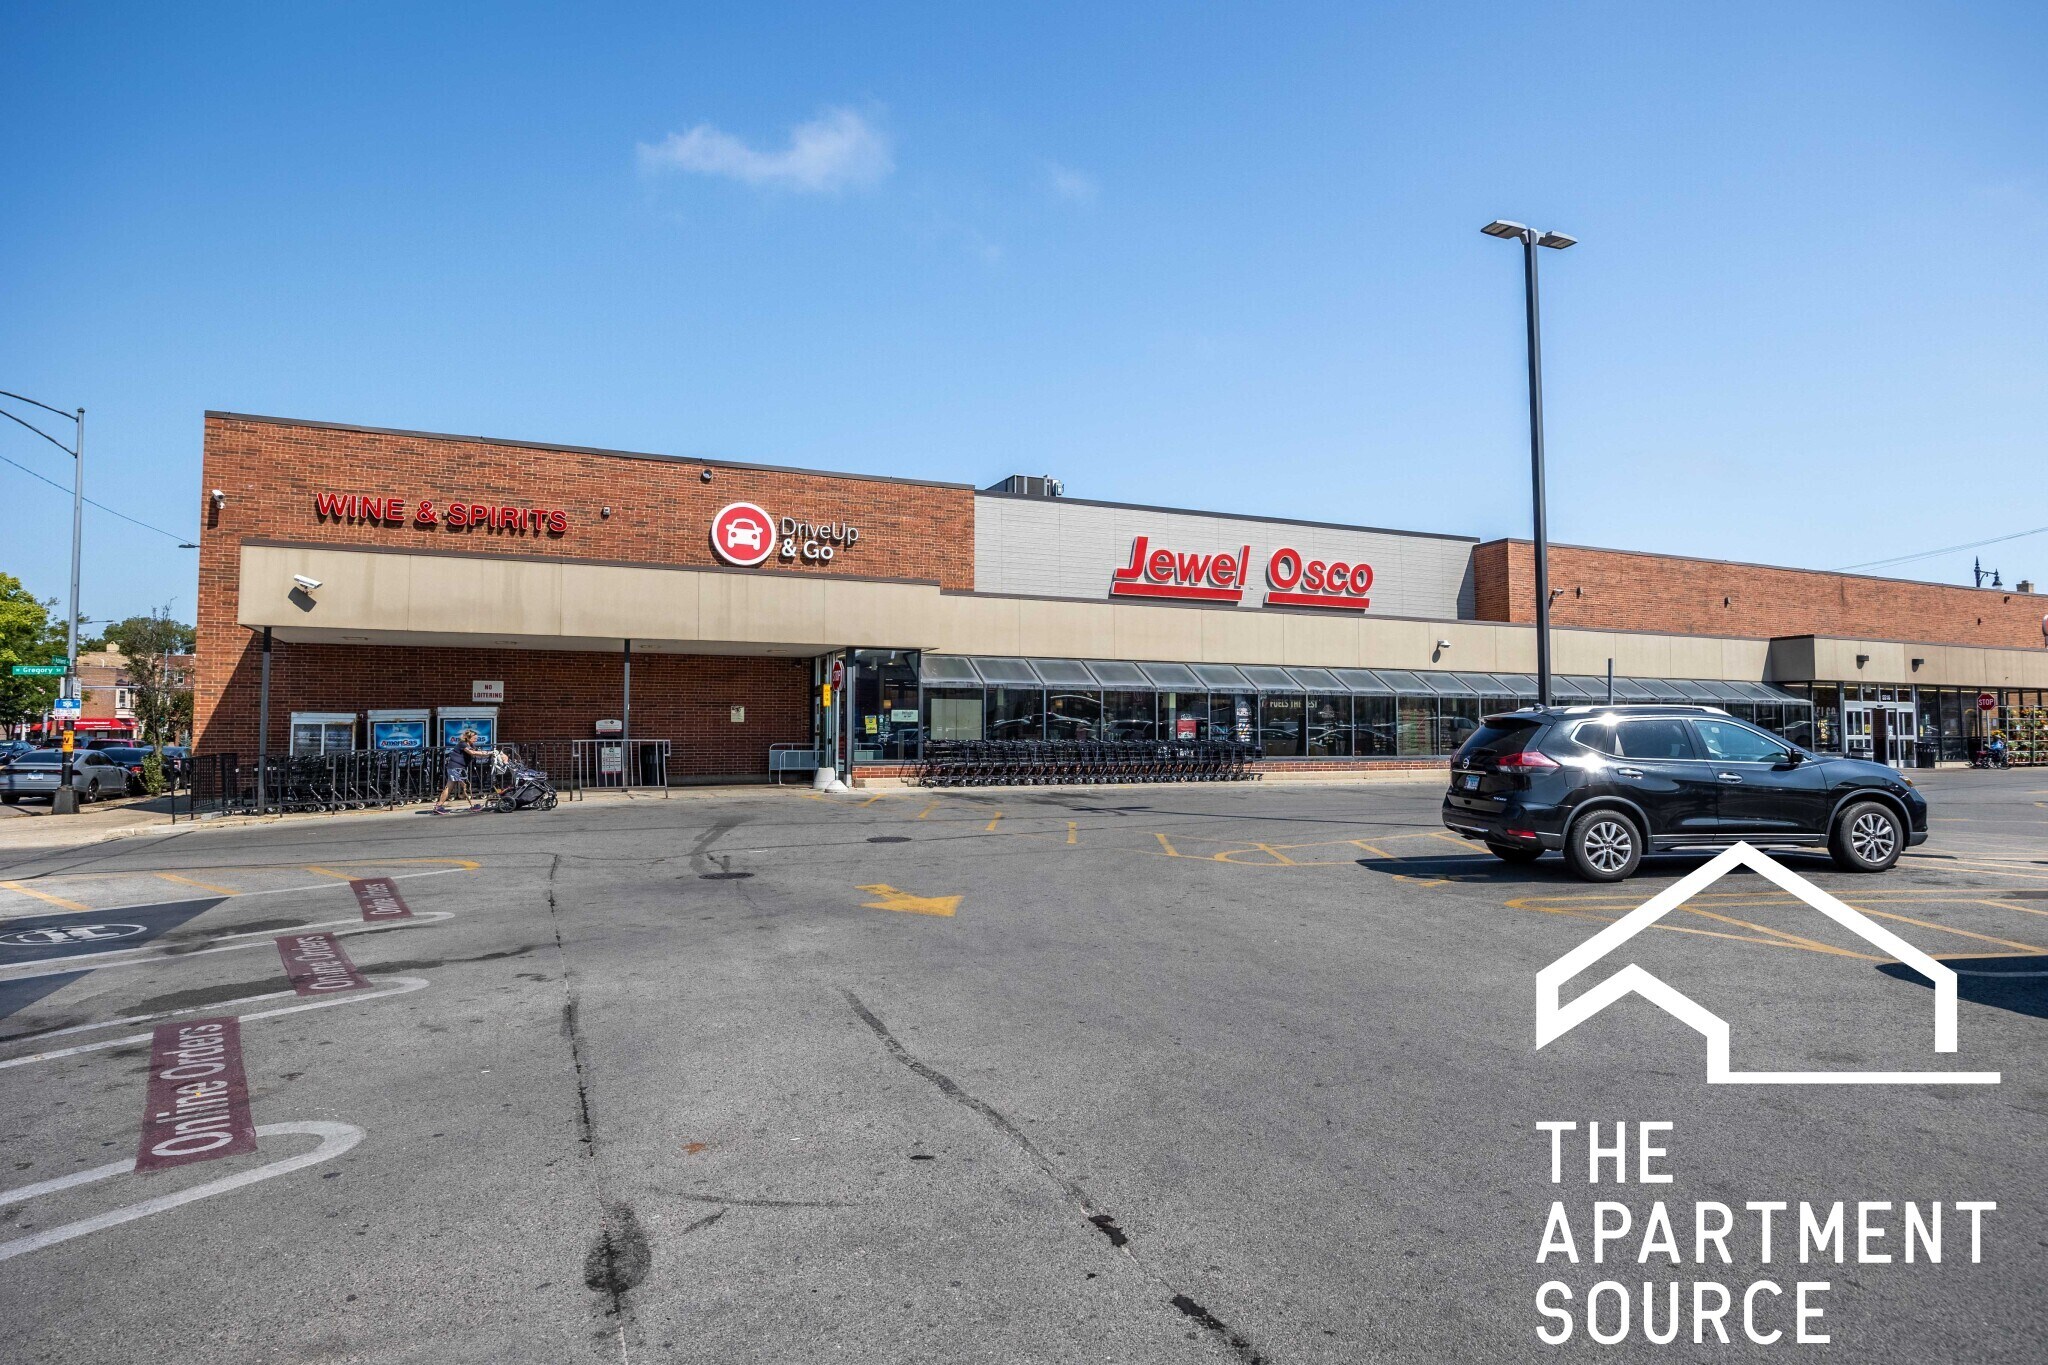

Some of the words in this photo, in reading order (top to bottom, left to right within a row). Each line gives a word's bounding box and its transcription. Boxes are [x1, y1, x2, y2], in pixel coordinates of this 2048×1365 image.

[317, 493, 405, 520] WINE
[416, 500, 438, 524] &
[448, 503, 568, 532] SPIRITS
[781, 517, 859, 545] DriveUp
[782, 538, 797, 557] &
[803, 540, 834, 560] Go
[1113, 535, 1250, 587] Jewel
[1267, 547, 1374, 594] Osco
[1978, 698, 1994, 706] STOP
[380, 739, 418, 747] AmeriGas
[291, 935, 336, 961] Orders
[302, 960, 355, 990] Online
[159, 1023, 226, 1080] Orders
[151, 1080, 234, 1156] Online
